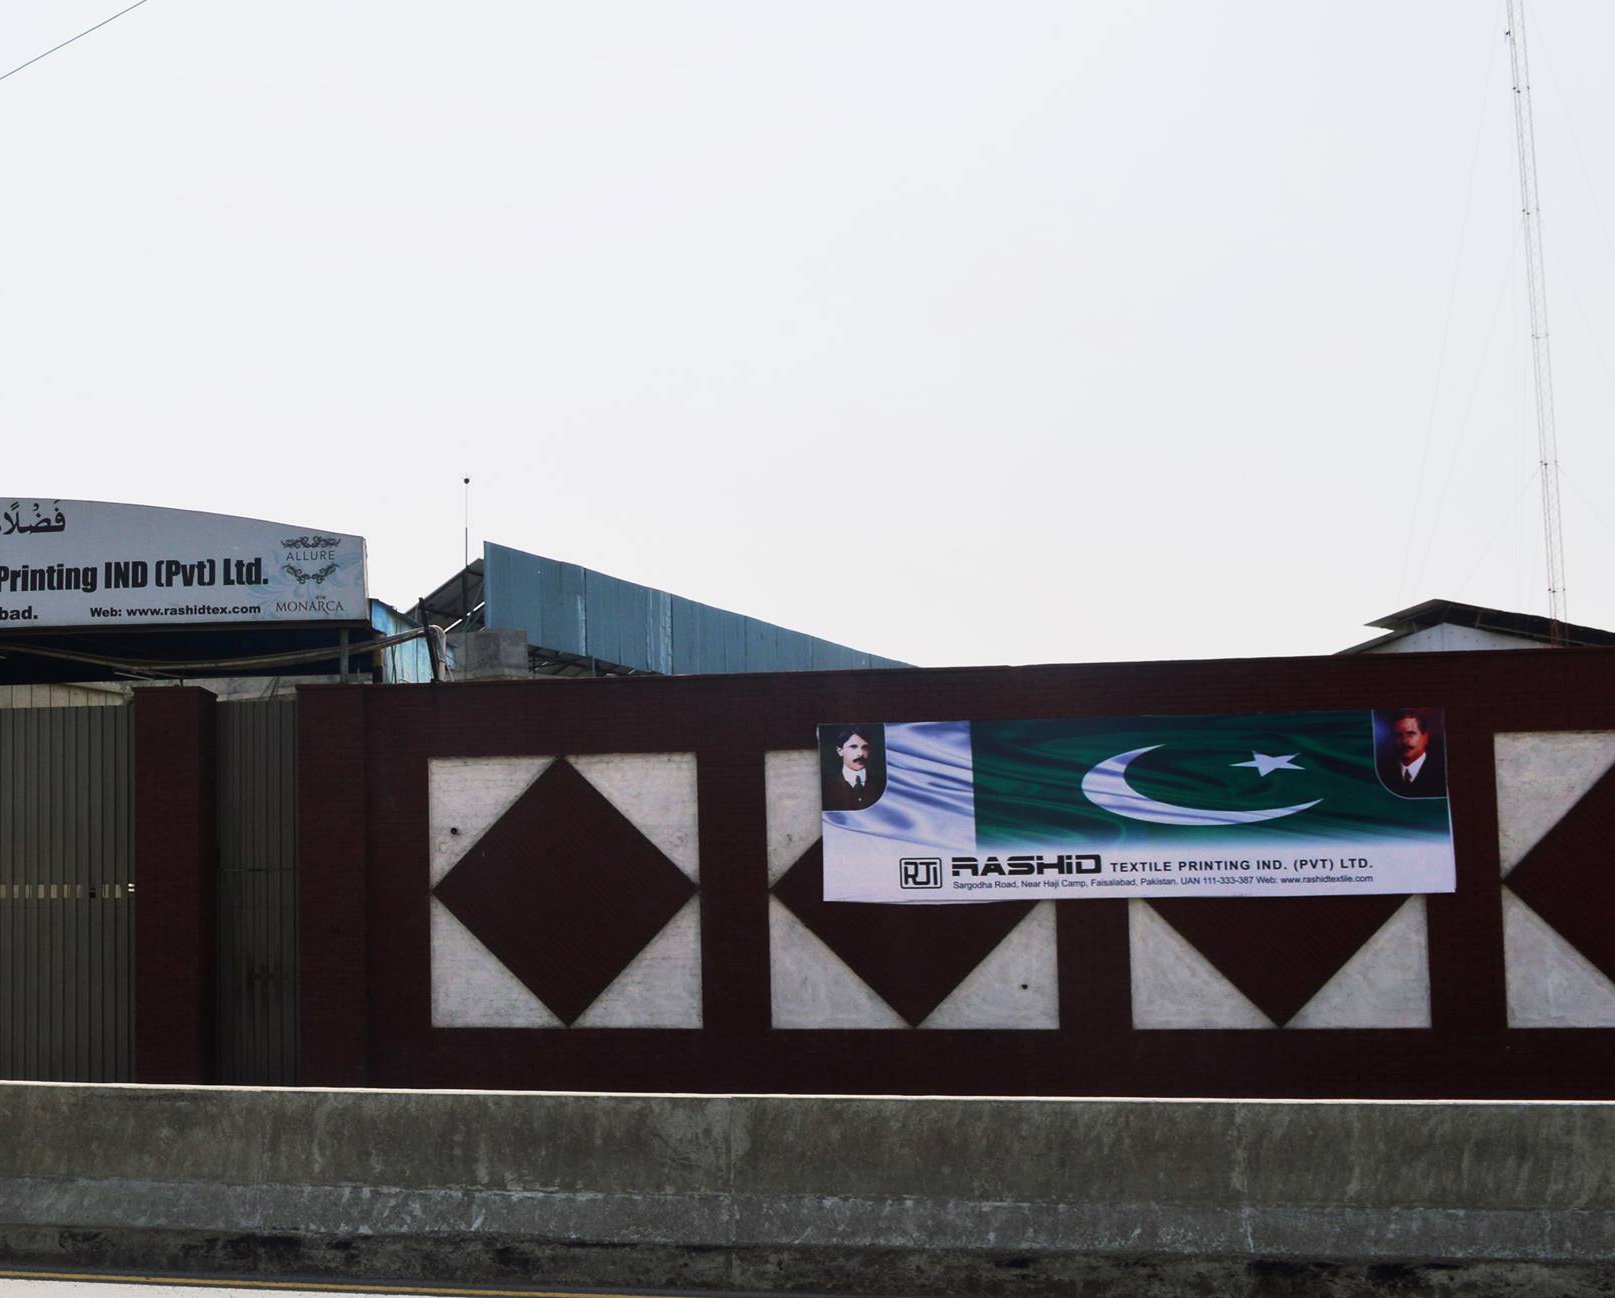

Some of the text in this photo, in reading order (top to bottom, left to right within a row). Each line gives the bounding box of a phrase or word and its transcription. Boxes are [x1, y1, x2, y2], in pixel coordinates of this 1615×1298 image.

[285, 550, 336, 561] ALLURE
[105, 561, 147, 589] IND
[155, 559, 215, 587] (Pvt)
[223, 558, 268, 585] Ltd.
[90, 605, 260, 617] Web: www.rashidtex.com
[275, 599, 344, 615] MONARCA
[1110, 862, 1171, 872] TEXTILE
[1179, 860, 1250, 871] PRINTING
[1257, 860, 1287, 870] IND.
[1294, 859, 1333, 872] (PVT)
[1341, 858, 1372, 868] LTD.
[953, 882, 992, 890] Sargodha
[1043, 880, 1059, 889] Haji
[1181, 877, 1200, 885] UAN
[1203, 876, 1254, 884] 111-333-387
[1280, 874, 1374, 884] www.rashidtextile.com
